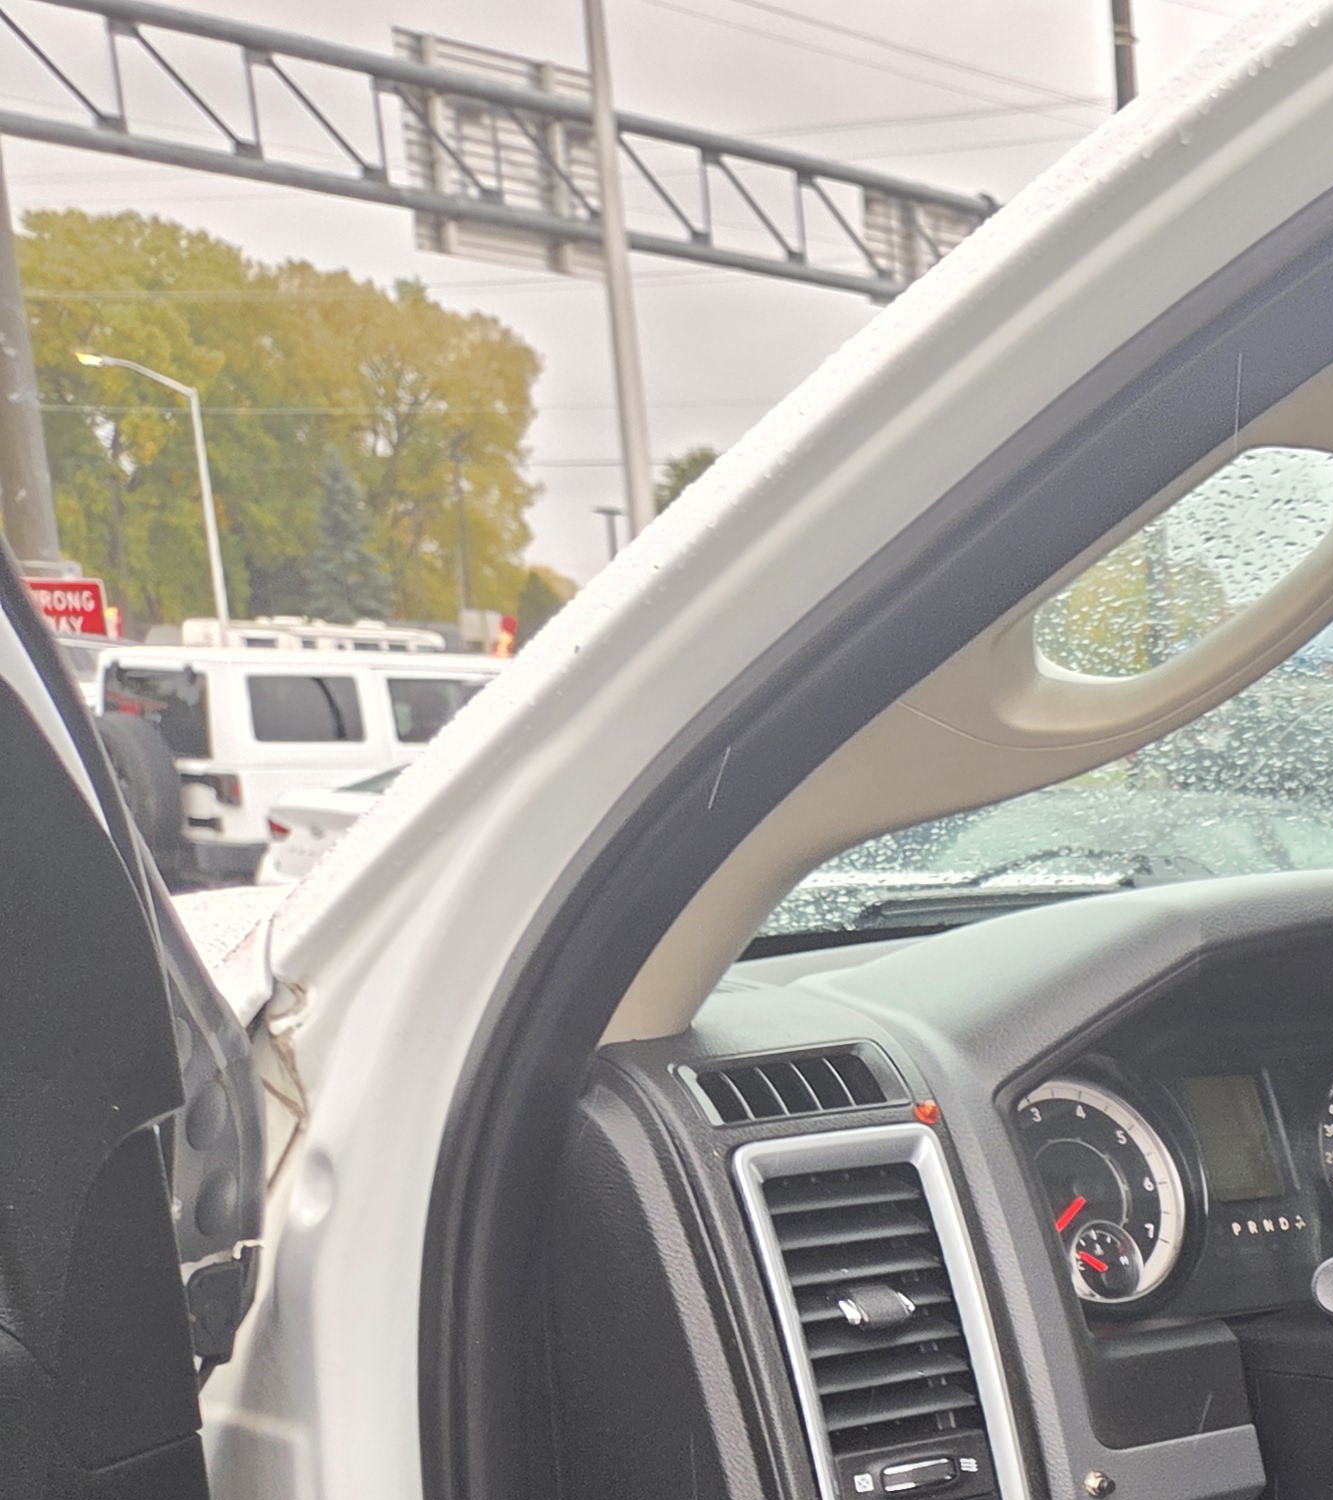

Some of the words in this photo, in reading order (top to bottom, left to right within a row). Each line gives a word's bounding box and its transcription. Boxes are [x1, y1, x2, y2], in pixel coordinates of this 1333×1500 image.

[1029, 1107, 1042, 1122] 3
[1076, 1104, 1086, 1119] 4
[1115, 1130, 1127, 1145] 5
[1143, 1176, 1154, 1191] 6
[1144, 1223, 1155, 1238] 7
[1231, 1222, 1242, 1236] P
[1247, 1220, 1258, 1234] R
[1263, 1219, 1275, 1232] N
[1278, 1216, 1290, 1230] D
